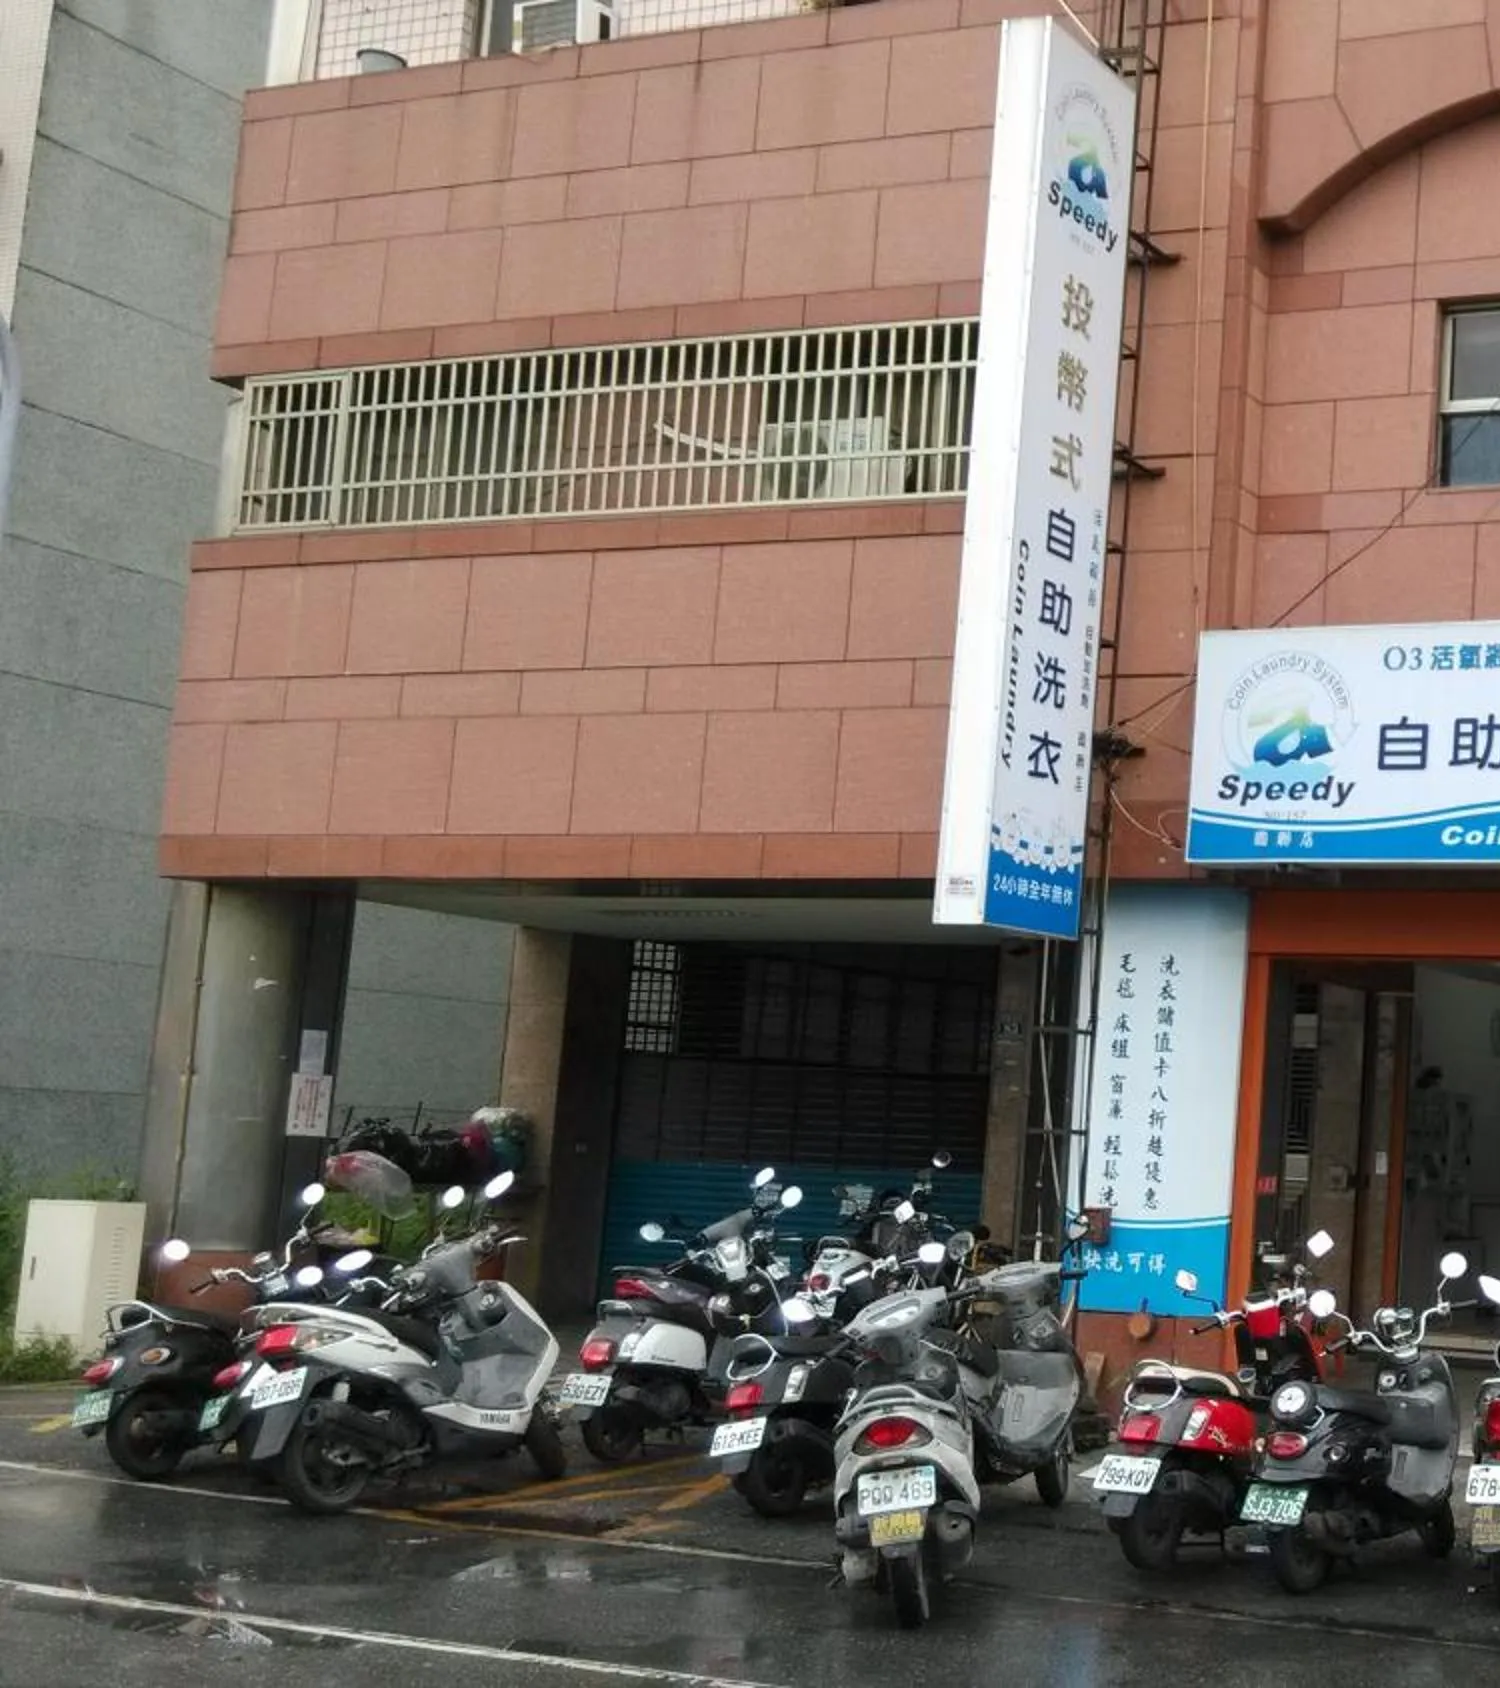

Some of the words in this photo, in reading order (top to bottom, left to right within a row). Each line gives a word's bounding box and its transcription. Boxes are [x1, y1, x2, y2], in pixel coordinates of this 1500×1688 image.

[1048, 180, 1118, 252] Speedy
[1049, 273, 1095, 492] 投幣式
[1012, 539, 1030, 618] Coin
[1027, 507, 1077, 786] 自助洗衣
[1228, 676, 1253, 710] Coin
[1250, 654, 1311, 681] Laundry
[1312, 659, 1349, 709] System
[1000, 626, 1024, 770] Laundry
[1218, 774, 1356, 808] Speedy
